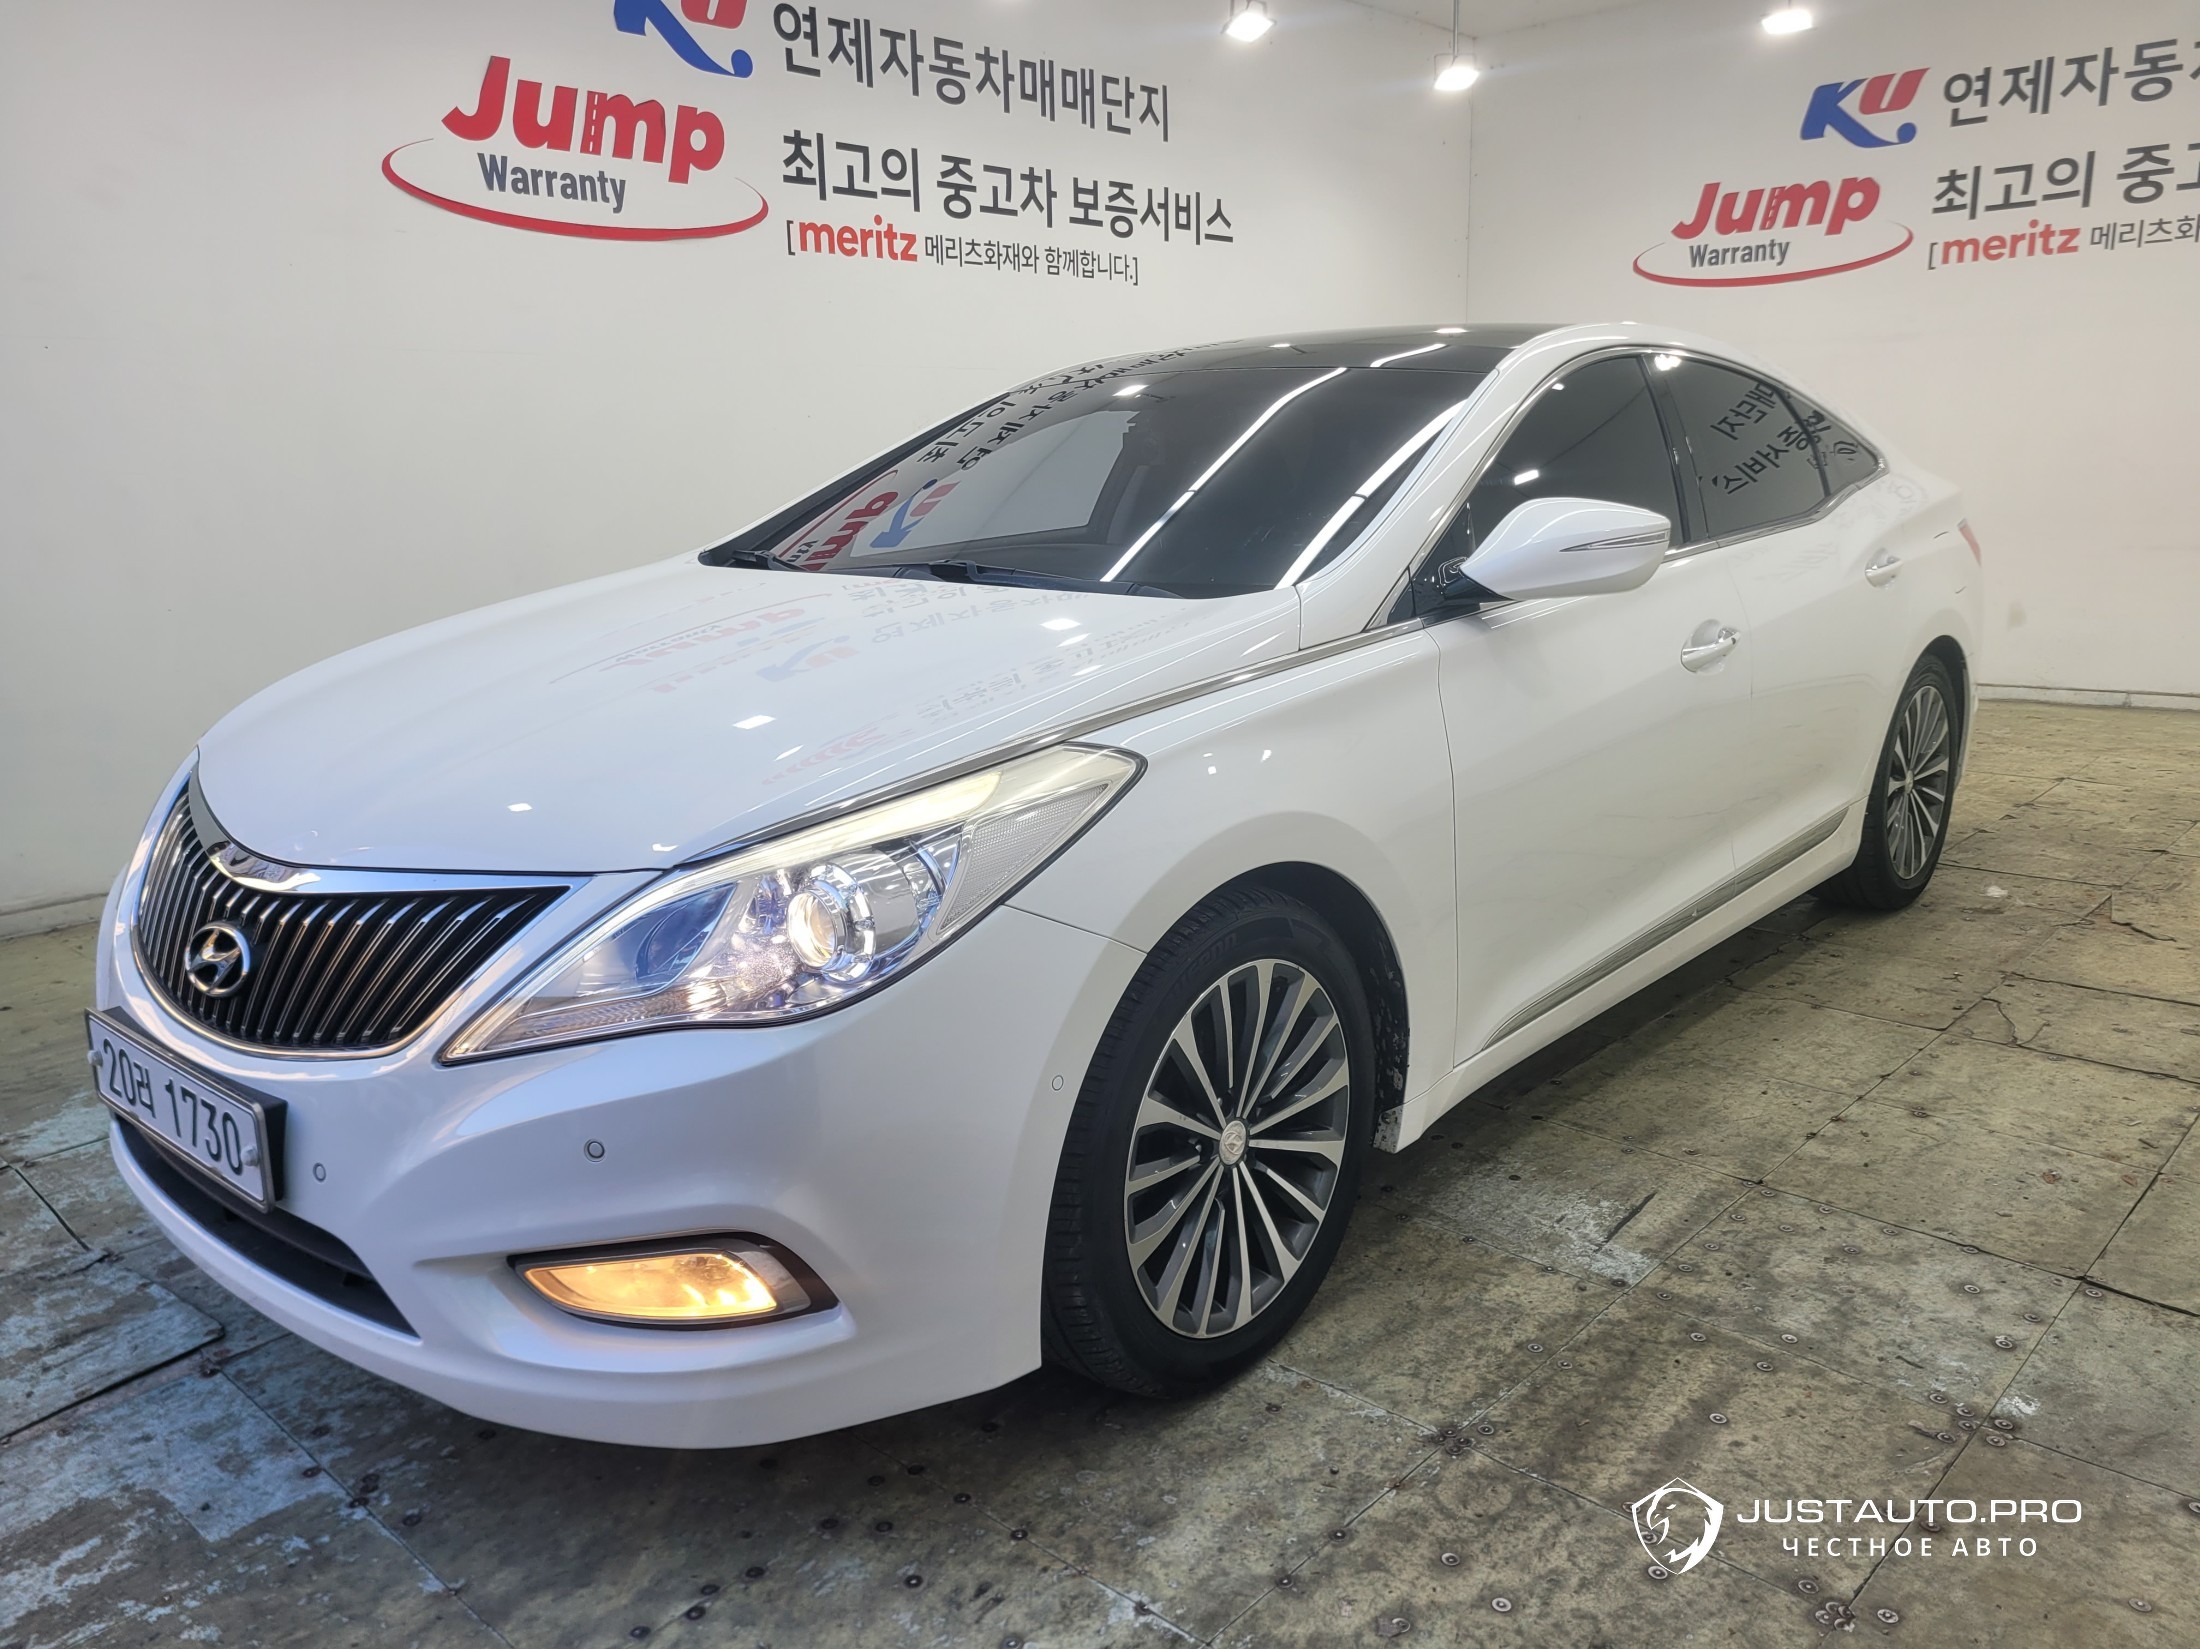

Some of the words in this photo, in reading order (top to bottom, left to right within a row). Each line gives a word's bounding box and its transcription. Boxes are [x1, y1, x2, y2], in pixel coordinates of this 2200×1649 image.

[773, 3, 1169, 142] 연제자동차매매단지
[1943, 38, 2200, 127] 연제자동
[441, 55, 725, 185] Jump
[477, 152, 626, 214] Warranty
[782, 129, 921, 213] 최고의
[936, 154, 1057, 228] 중고차
[1069, 176, 1234, 246] 보증서비스
[1671, 176, 1880, 240] Jump
[1932, 150, 2096, 221] 최고의
[924, 234, 1040, 274] 메리츠화재와
[1689, 238, 1790, 268] Warranty
[103, 1037, 157, 1119] 20러
[164, 1077, 244, 1176] 1730
